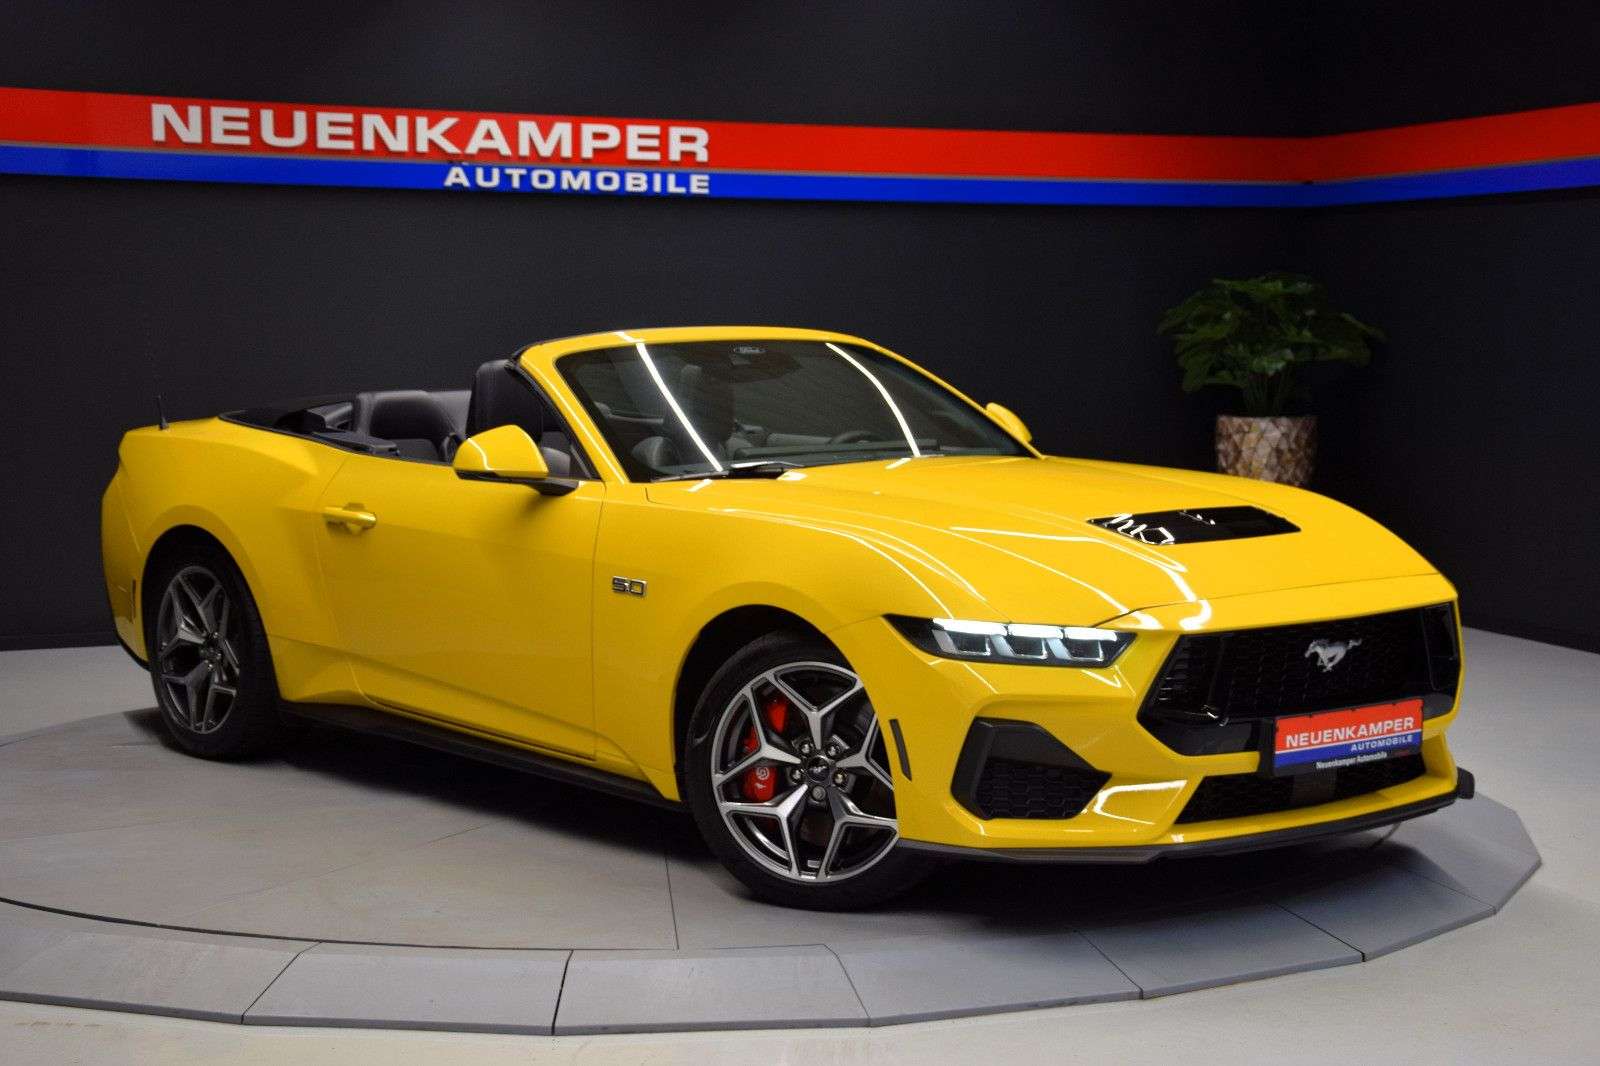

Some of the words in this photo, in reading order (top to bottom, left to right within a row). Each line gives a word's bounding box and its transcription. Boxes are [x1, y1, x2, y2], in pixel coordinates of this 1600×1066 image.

[151, 103, 710, 163] NEUENKAMPER
[444, 166, 710, 194] AUTOMOBILE
[612, 576, 647, 595] 5.0
[1285, 716, 1414, 748] NEUENKAMPER
[1351, 734, 1413, 752] AUTOMOBILE
